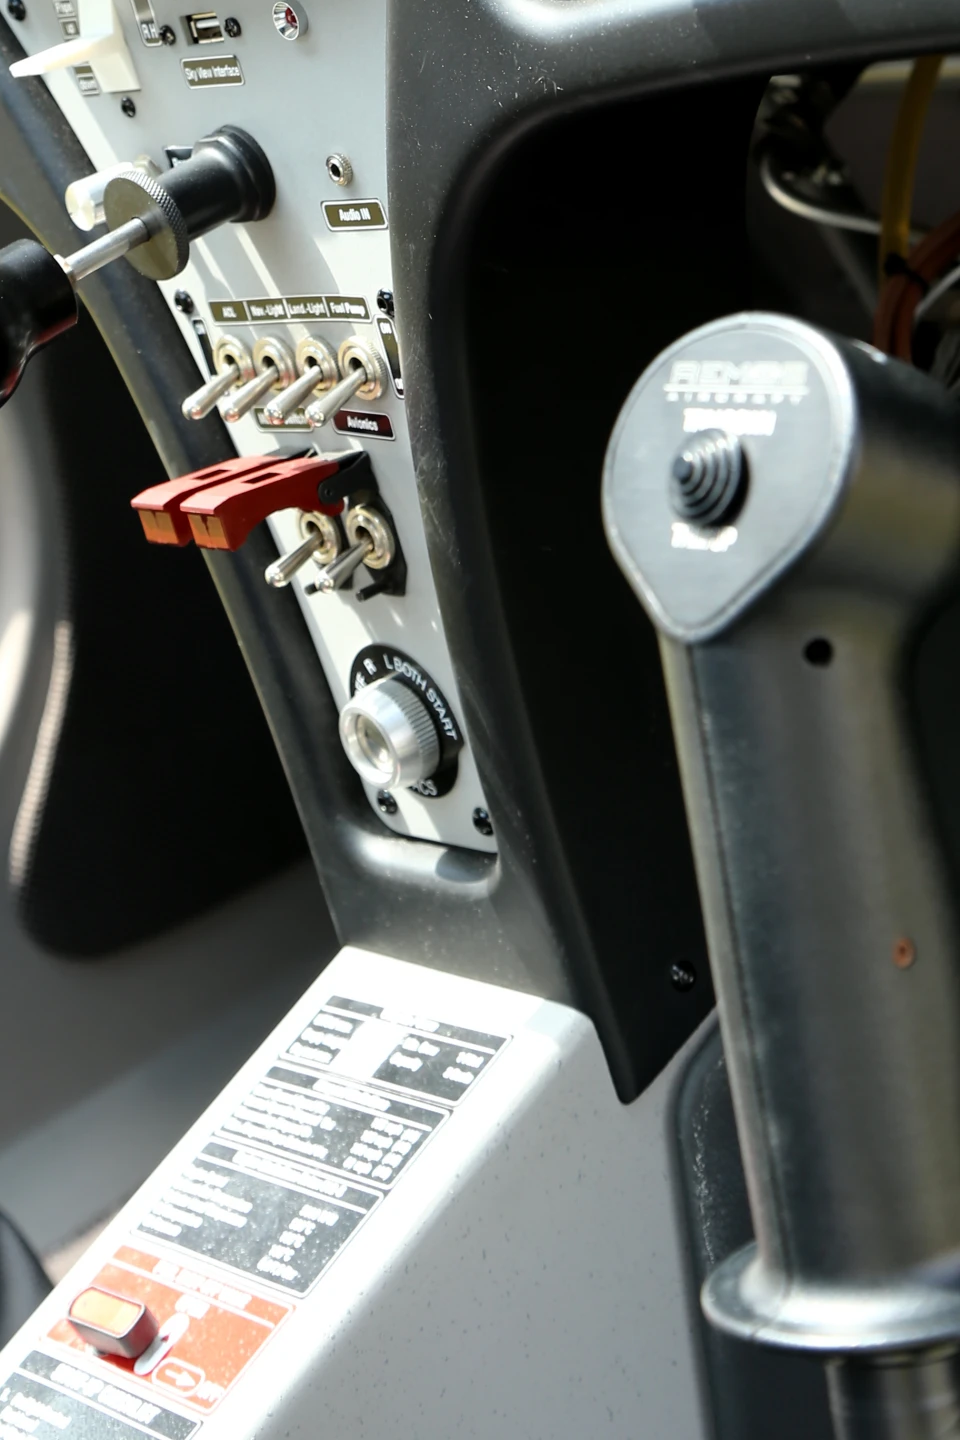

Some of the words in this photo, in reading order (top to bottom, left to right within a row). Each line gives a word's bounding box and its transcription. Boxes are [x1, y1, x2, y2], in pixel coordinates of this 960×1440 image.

[141, 23, 159, 39] RH
[338, 208, 359, 222] Audio
[360, 208, 371, 220] IN
[330, 302, 346, 314] Fuel
[345, 303, 366, 317] Pump
[346, 416, 379, 432] Avionics
[363, 658, 377, 675] R
[383, 653, 393, 670] L
[393, 656, 427, 691] BOTH
[426, 688, 457, 740] START
